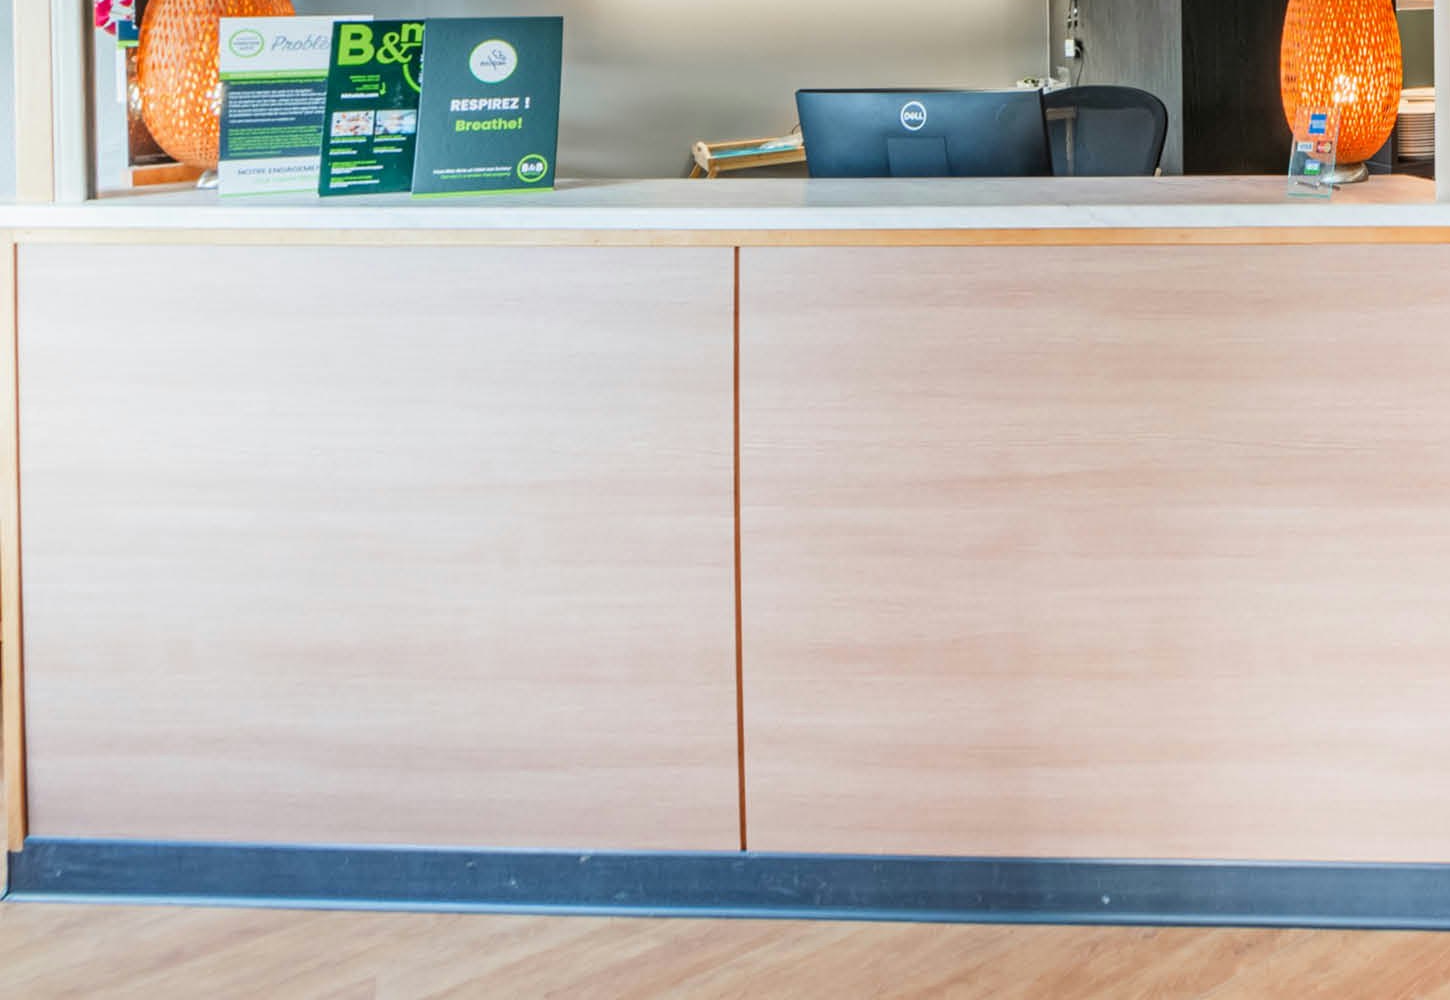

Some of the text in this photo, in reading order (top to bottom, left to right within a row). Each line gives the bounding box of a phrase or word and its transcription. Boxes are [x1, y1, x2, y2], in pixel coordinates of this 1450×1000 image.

[450, 97, 520, 112] RESPIREZ
[903, 111, 924, 121] DELL
[455, 117, 523, 132] Breathe!
